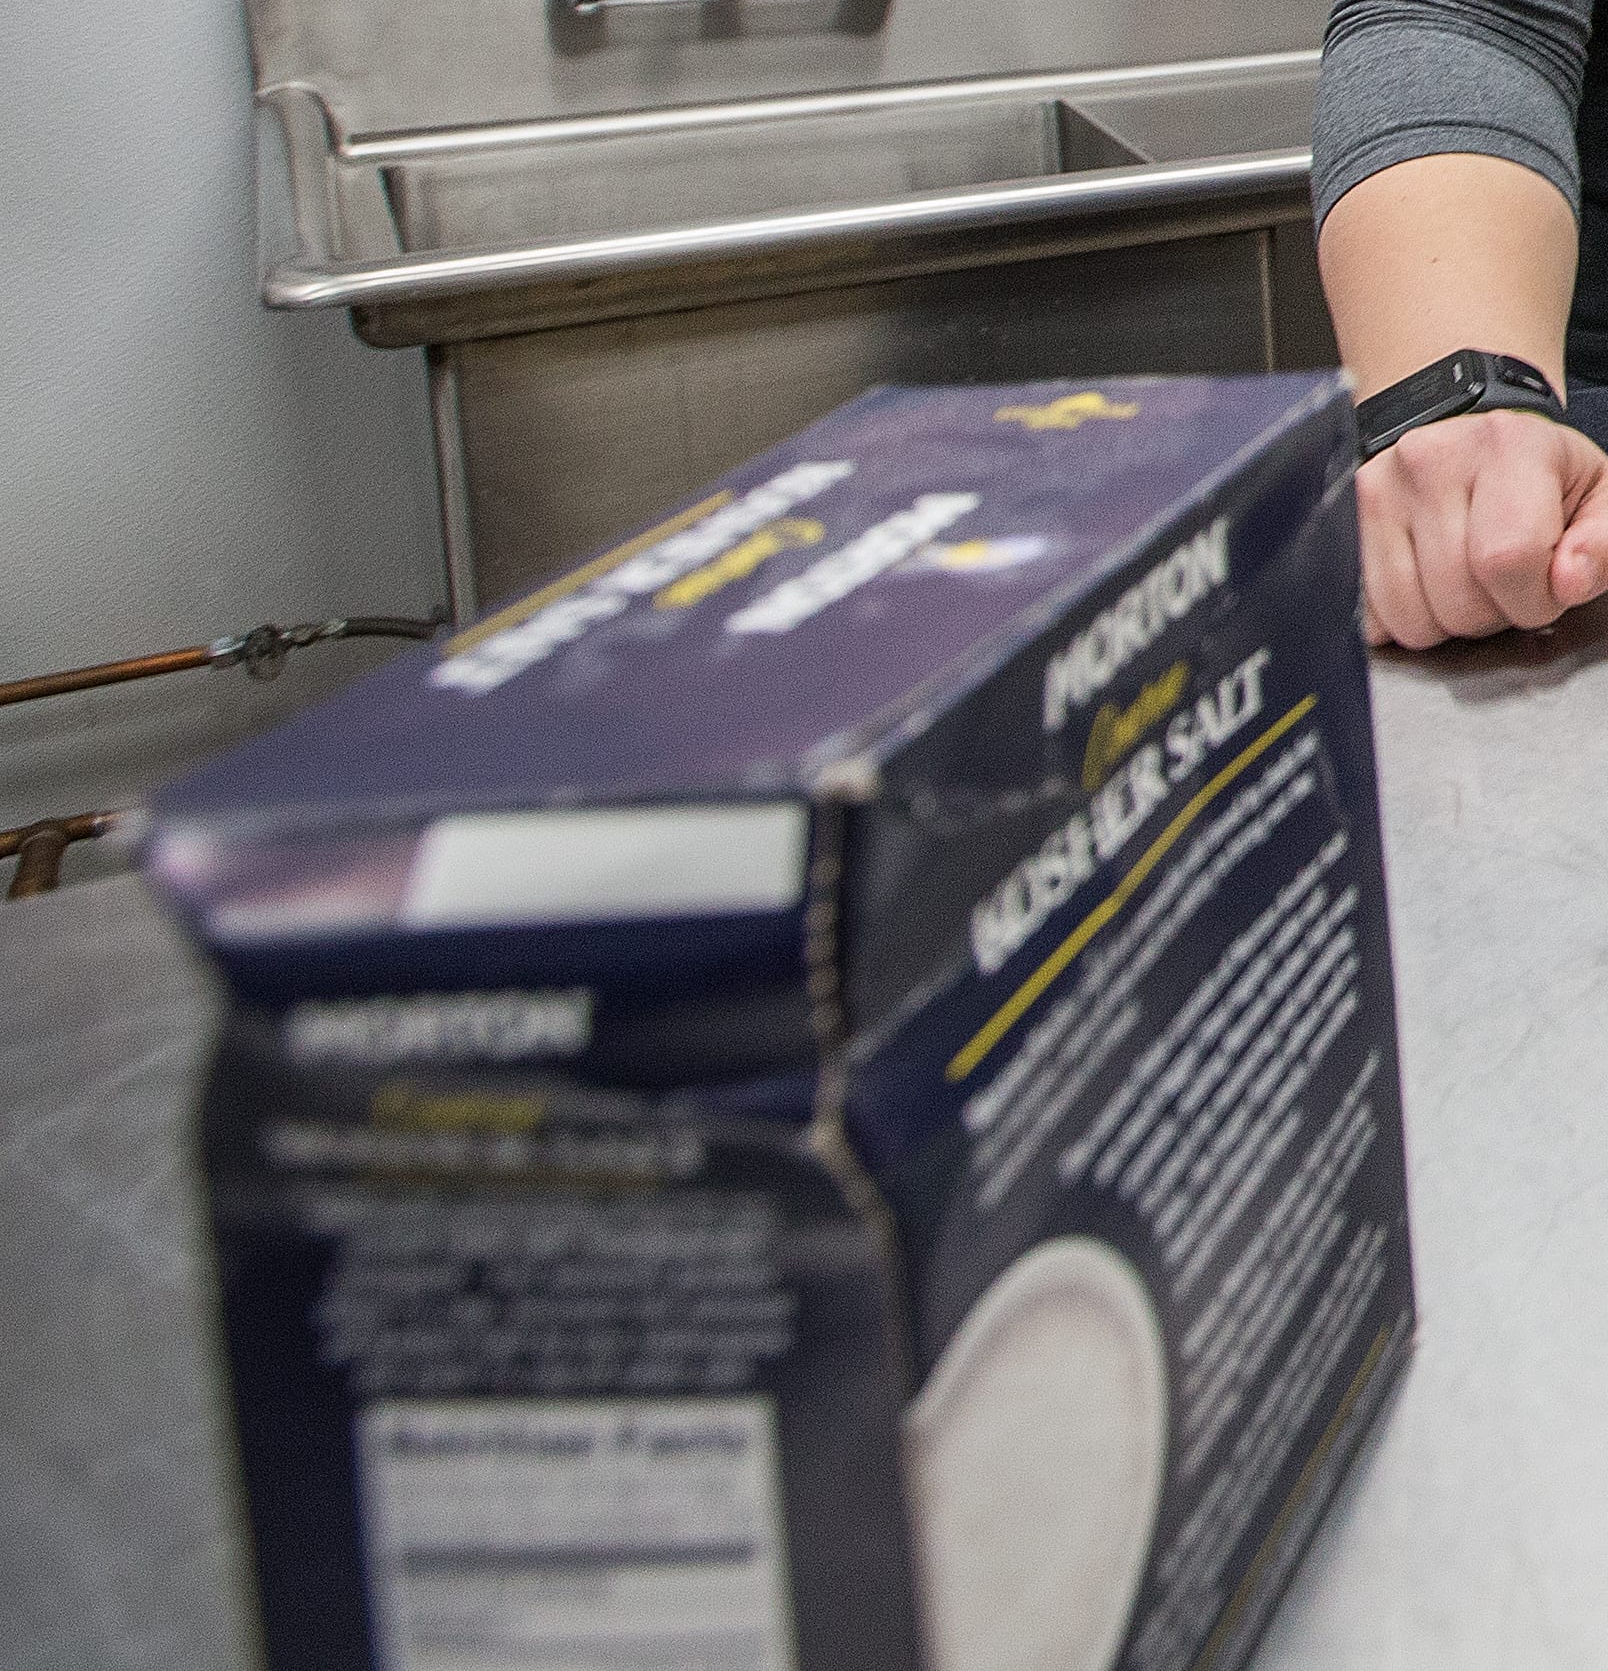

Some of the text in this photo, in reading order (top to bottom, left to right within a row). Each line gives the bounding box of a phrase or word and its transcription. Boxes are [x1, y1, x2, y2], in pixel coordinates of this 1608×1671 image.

[1041, 515, 1232, 732] MORTON
[973, 647, 1273, 977] KOSHER SALT
